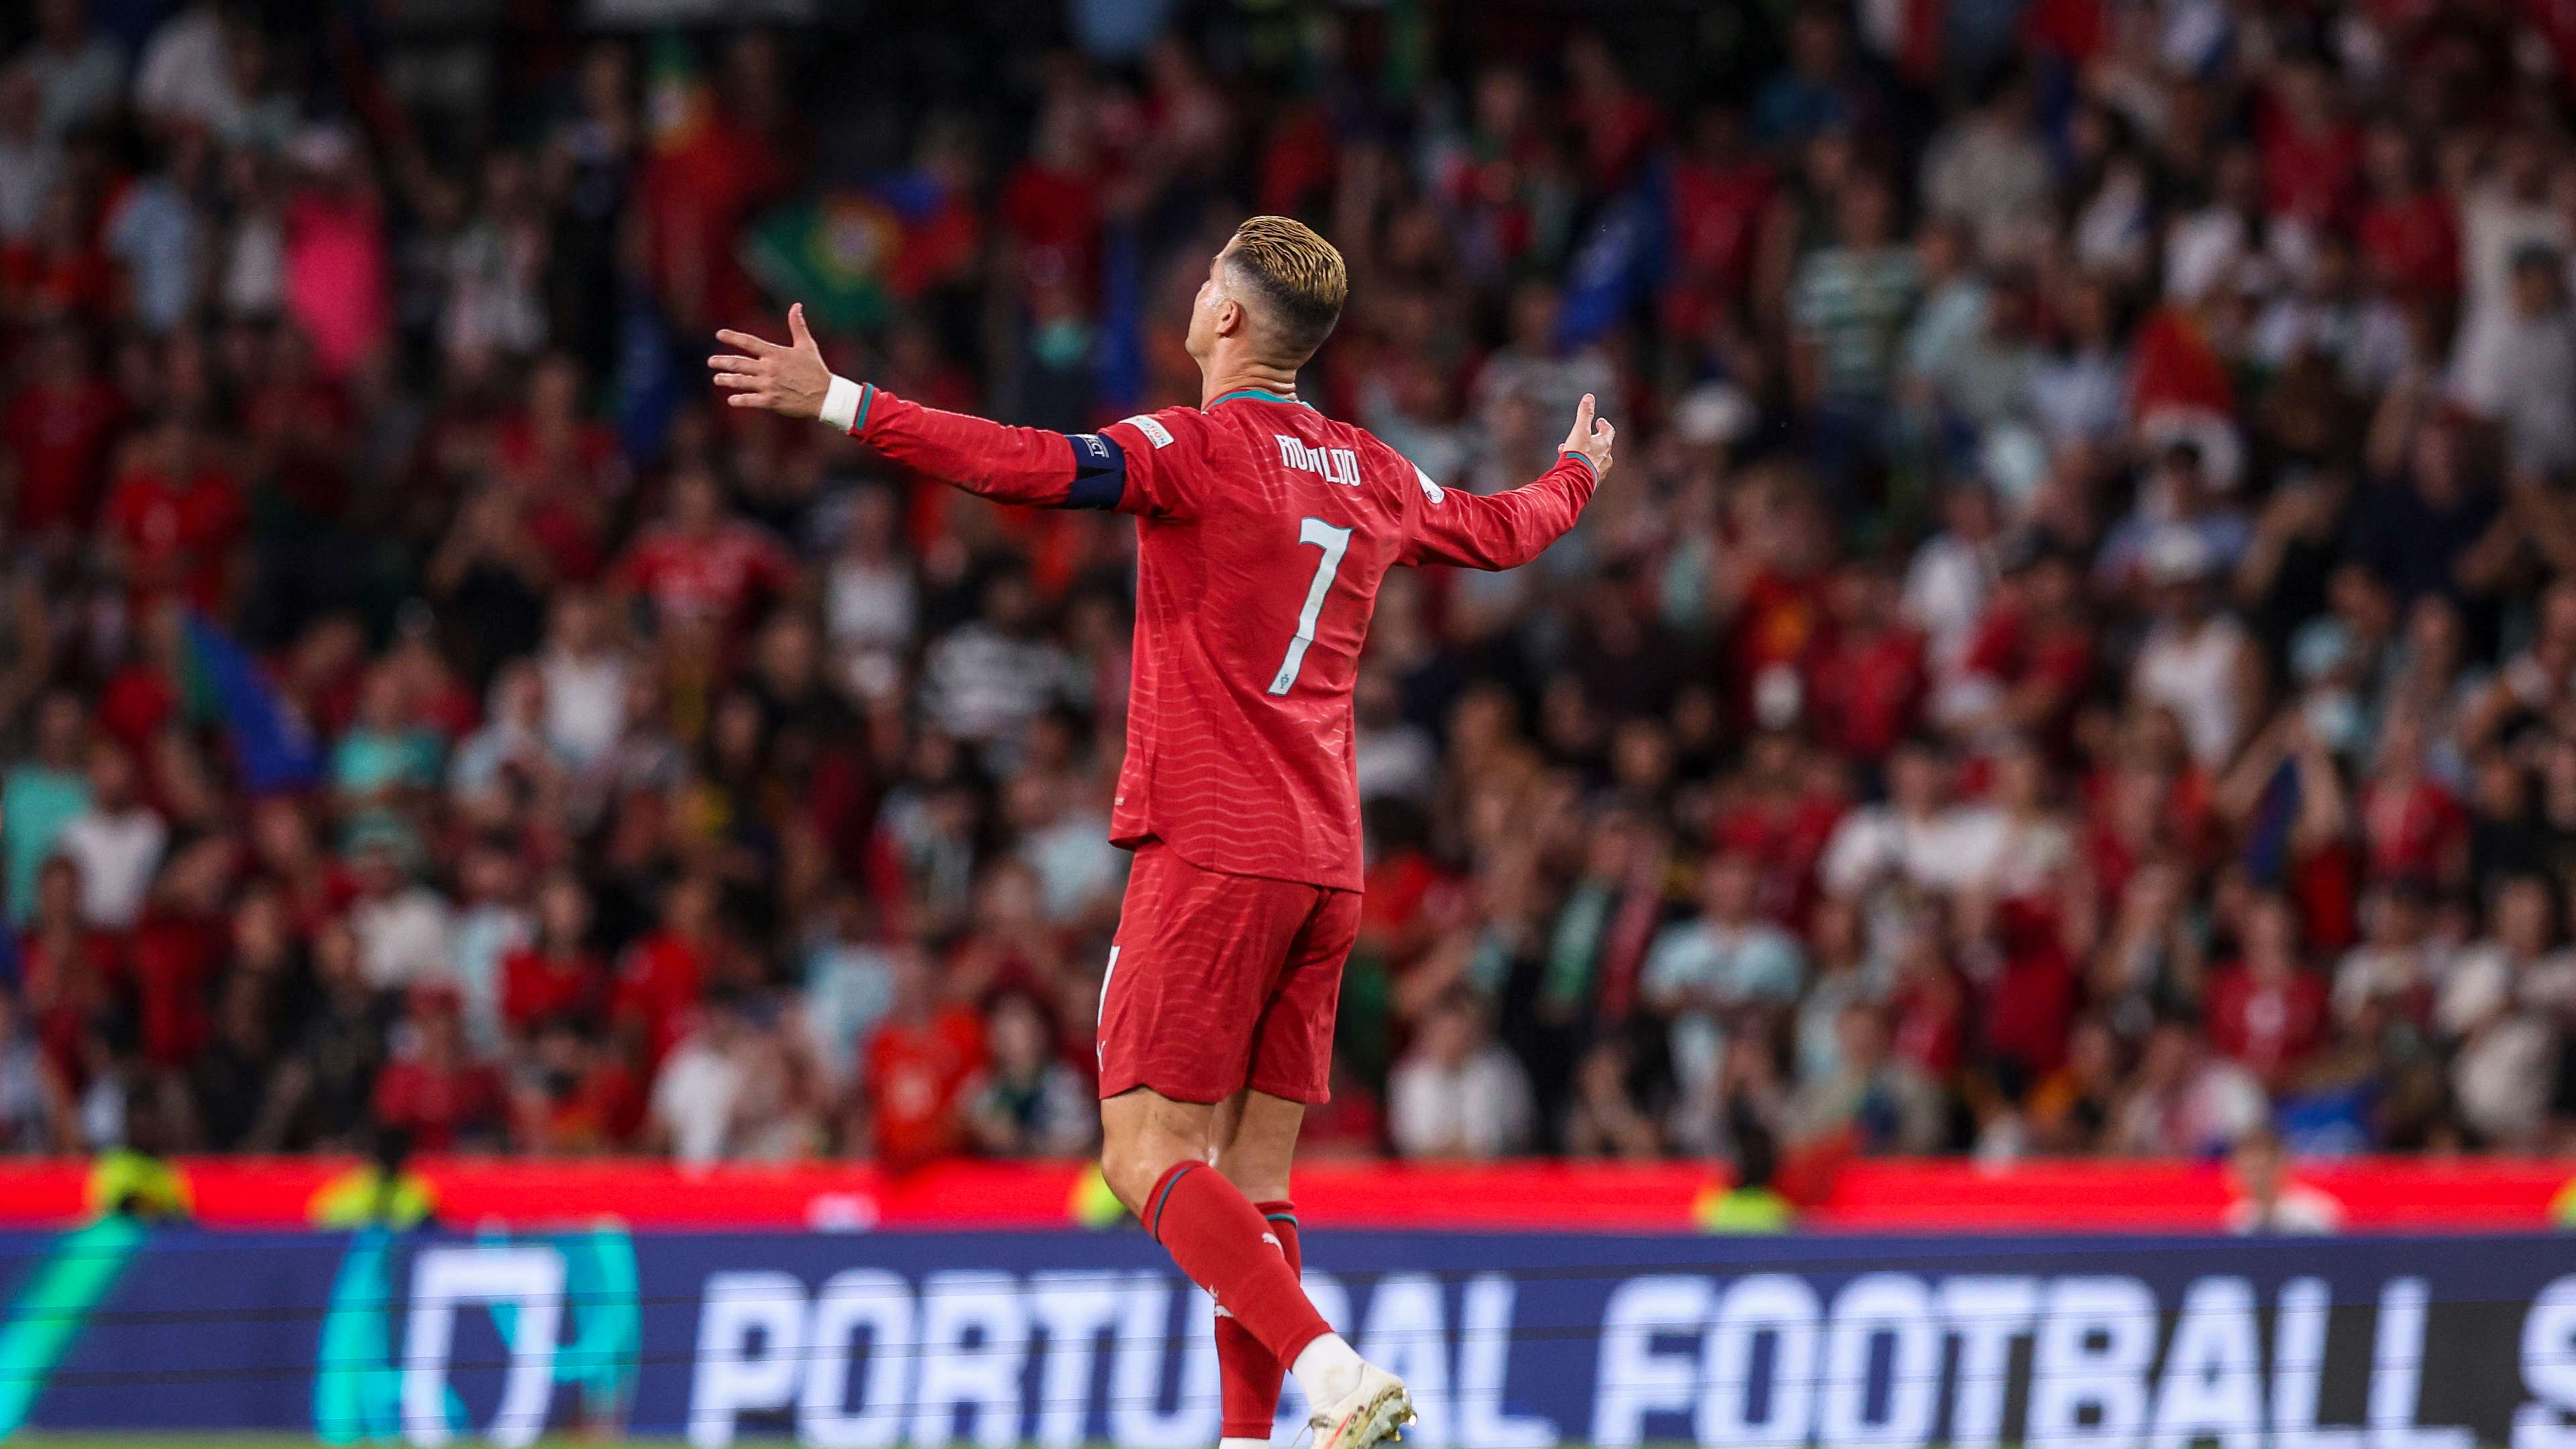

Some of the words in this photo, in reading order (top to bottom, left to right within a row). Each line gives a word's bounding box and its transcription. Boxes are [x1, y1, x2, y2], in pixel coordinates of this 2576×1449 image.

[1274, 434, 1361, 486] RONLDO
[1267, 517, 1354, 696] 7
[1591, 1272, 2477, 1449] FOOTBALL
